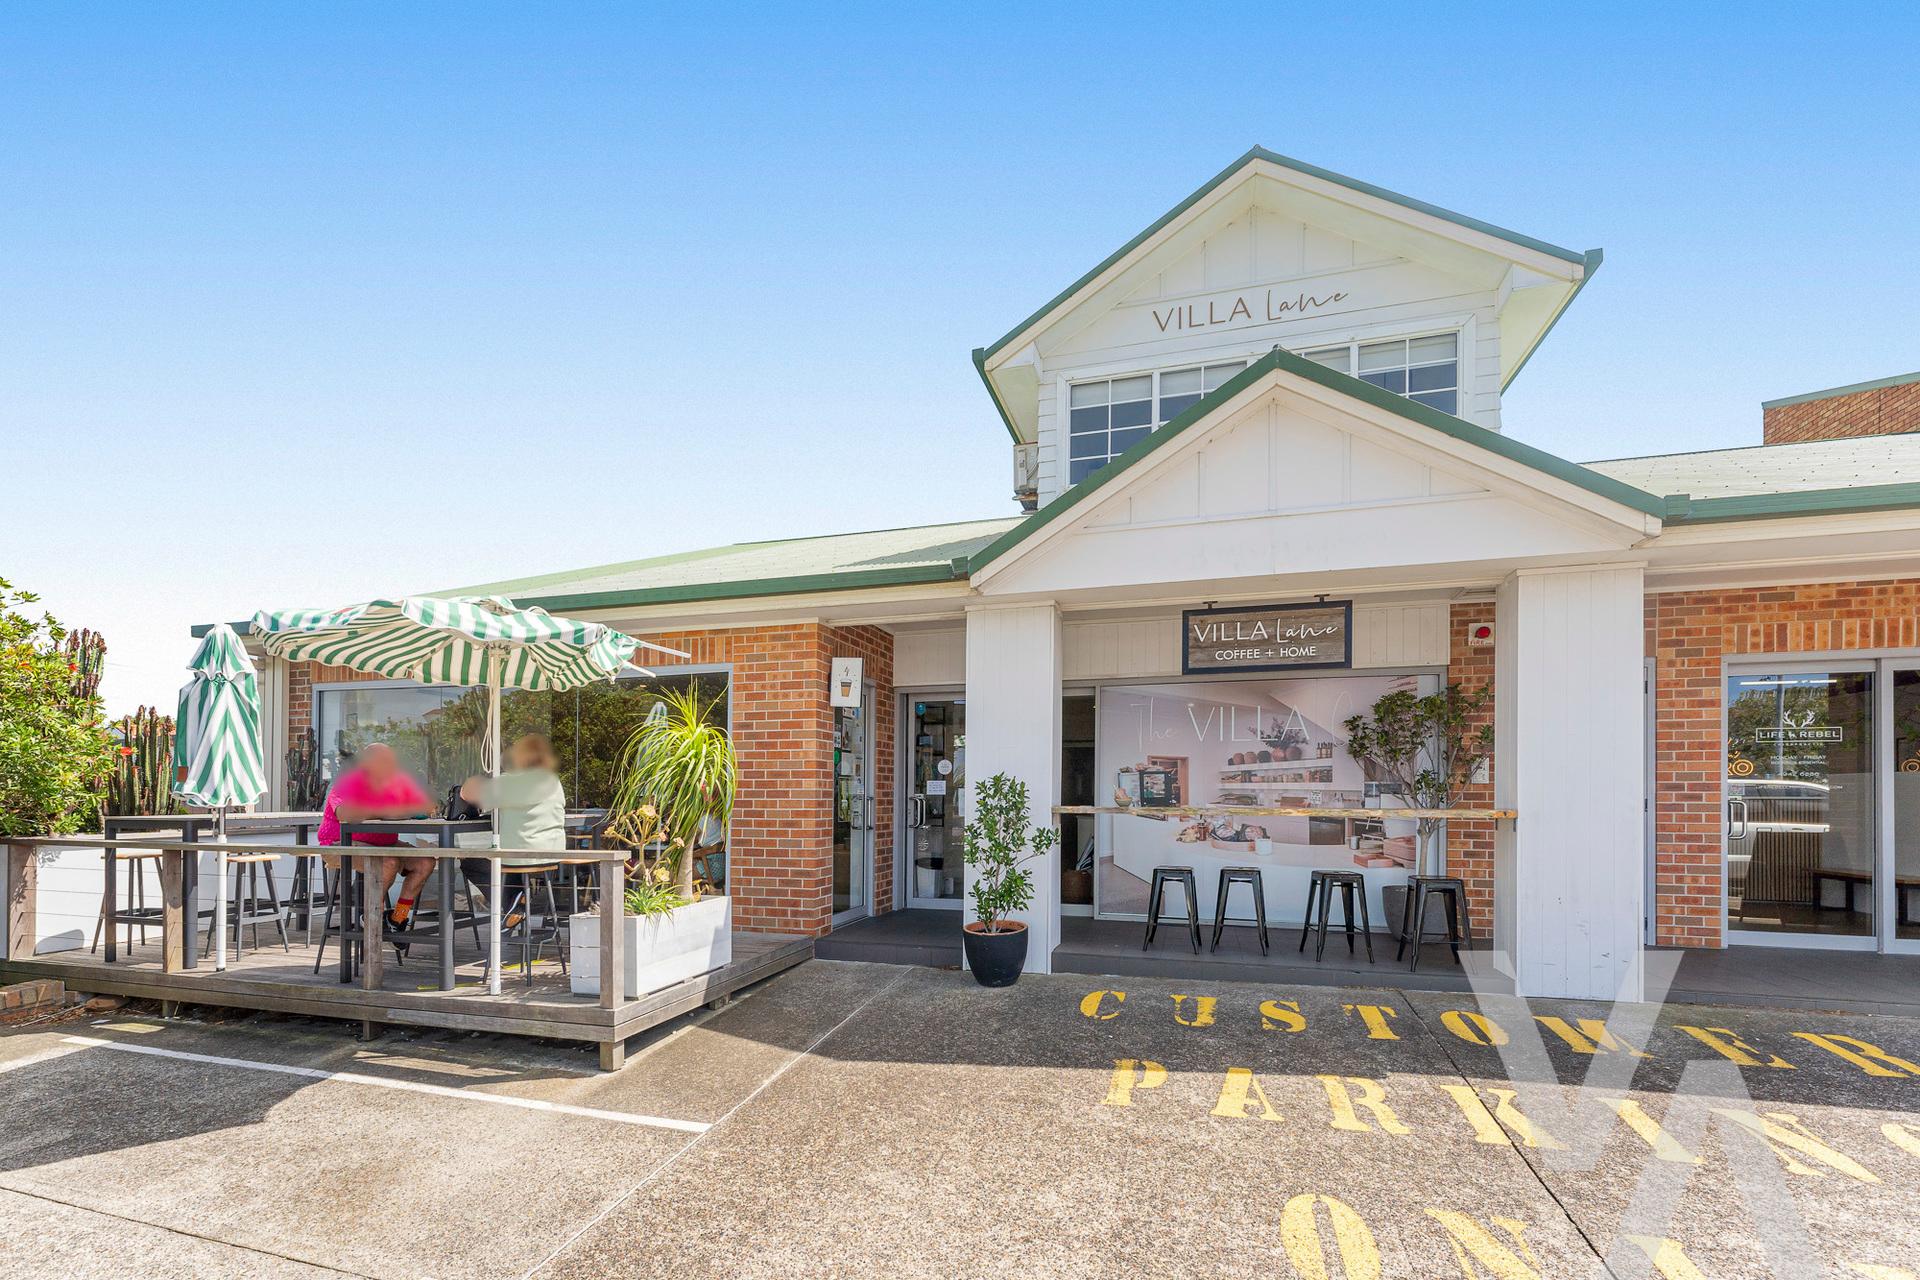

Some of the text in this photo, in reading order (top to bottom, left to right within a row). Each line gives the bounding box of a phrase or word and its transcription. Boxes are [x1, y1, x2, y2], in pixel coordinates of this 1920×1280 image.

[1152, 289, 1349, 332] VILLA Lane
[1193, 618, 1338, 643] VILLA Lane
[1215, 648, 1260, 661] COFFEE
[1280, 646, 1317, 657] HOME
[1130, 696, 1179, 752] The
[1187, 704, 1310, 742] VILLA
[1759, 731, 1785, 739] LIFE
[1799, 730, 1840, 738] REBEL
[1080, 989, 1920, 1078] CUSTOMER
[1280, 1192, 1920, 1280] ON
